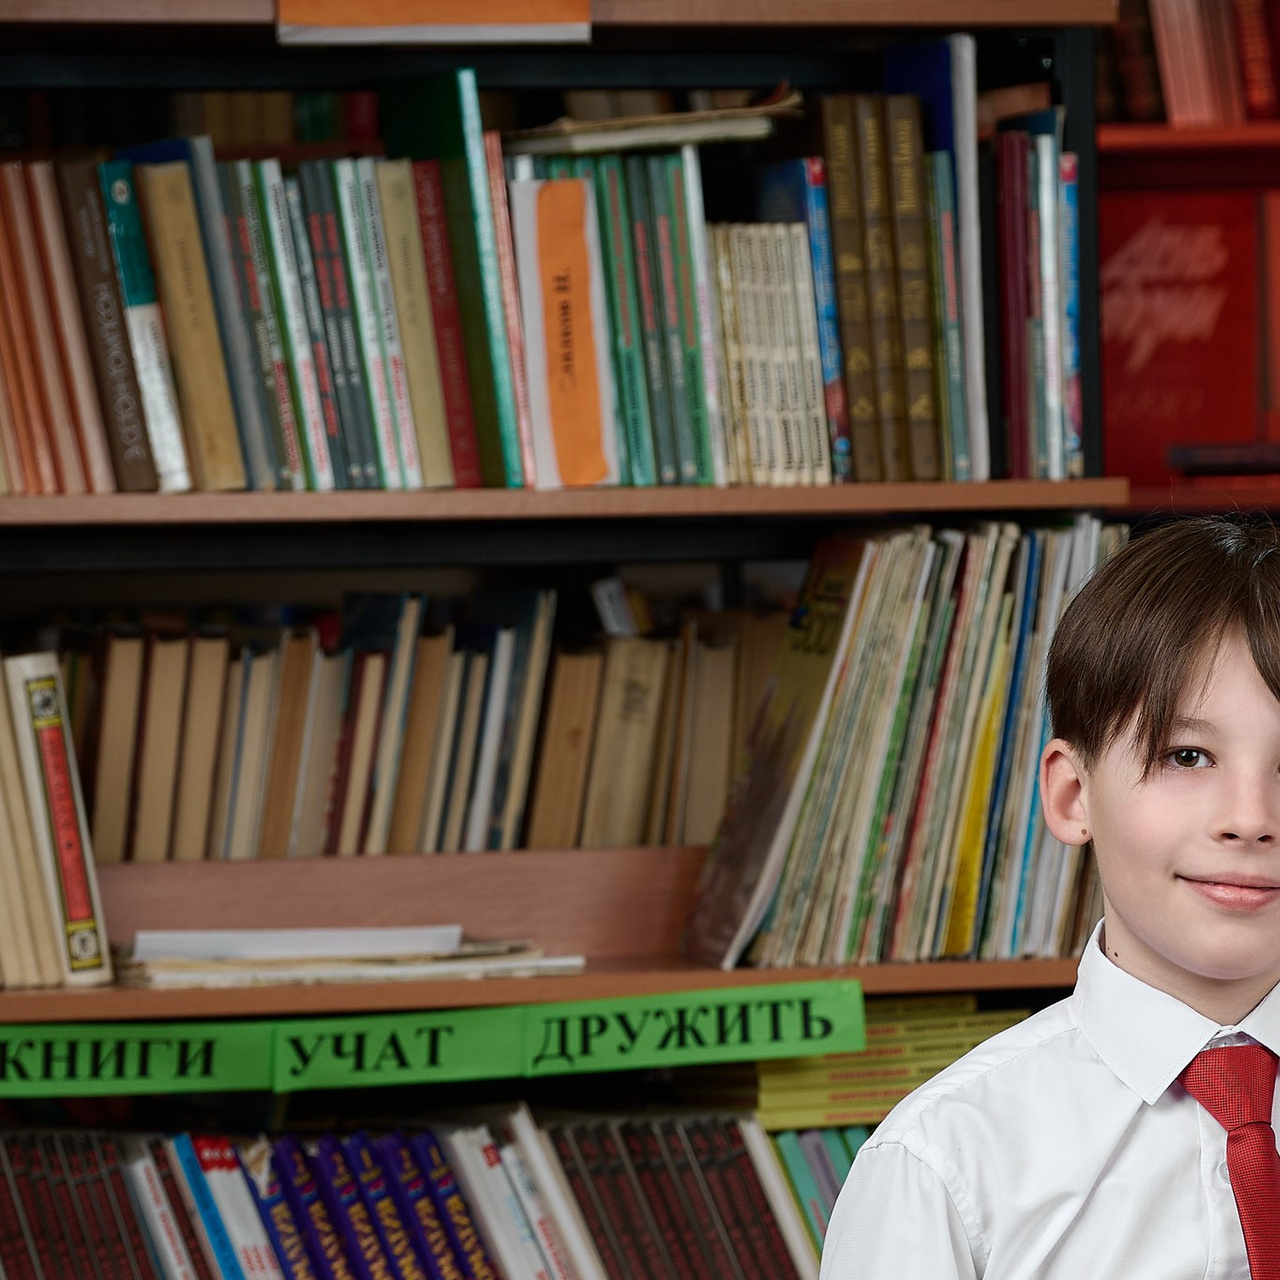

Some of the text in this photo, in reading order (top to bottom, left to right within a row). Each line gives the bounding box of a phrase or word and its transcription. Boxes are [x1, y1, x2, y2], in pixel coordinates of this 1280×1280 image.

[0, 1035, 219, 1082] КНИГИ
[286, 1025, 455, 1078] УЧАТ
[531, 998, 834, 1067] ДРУЖИТЬ
